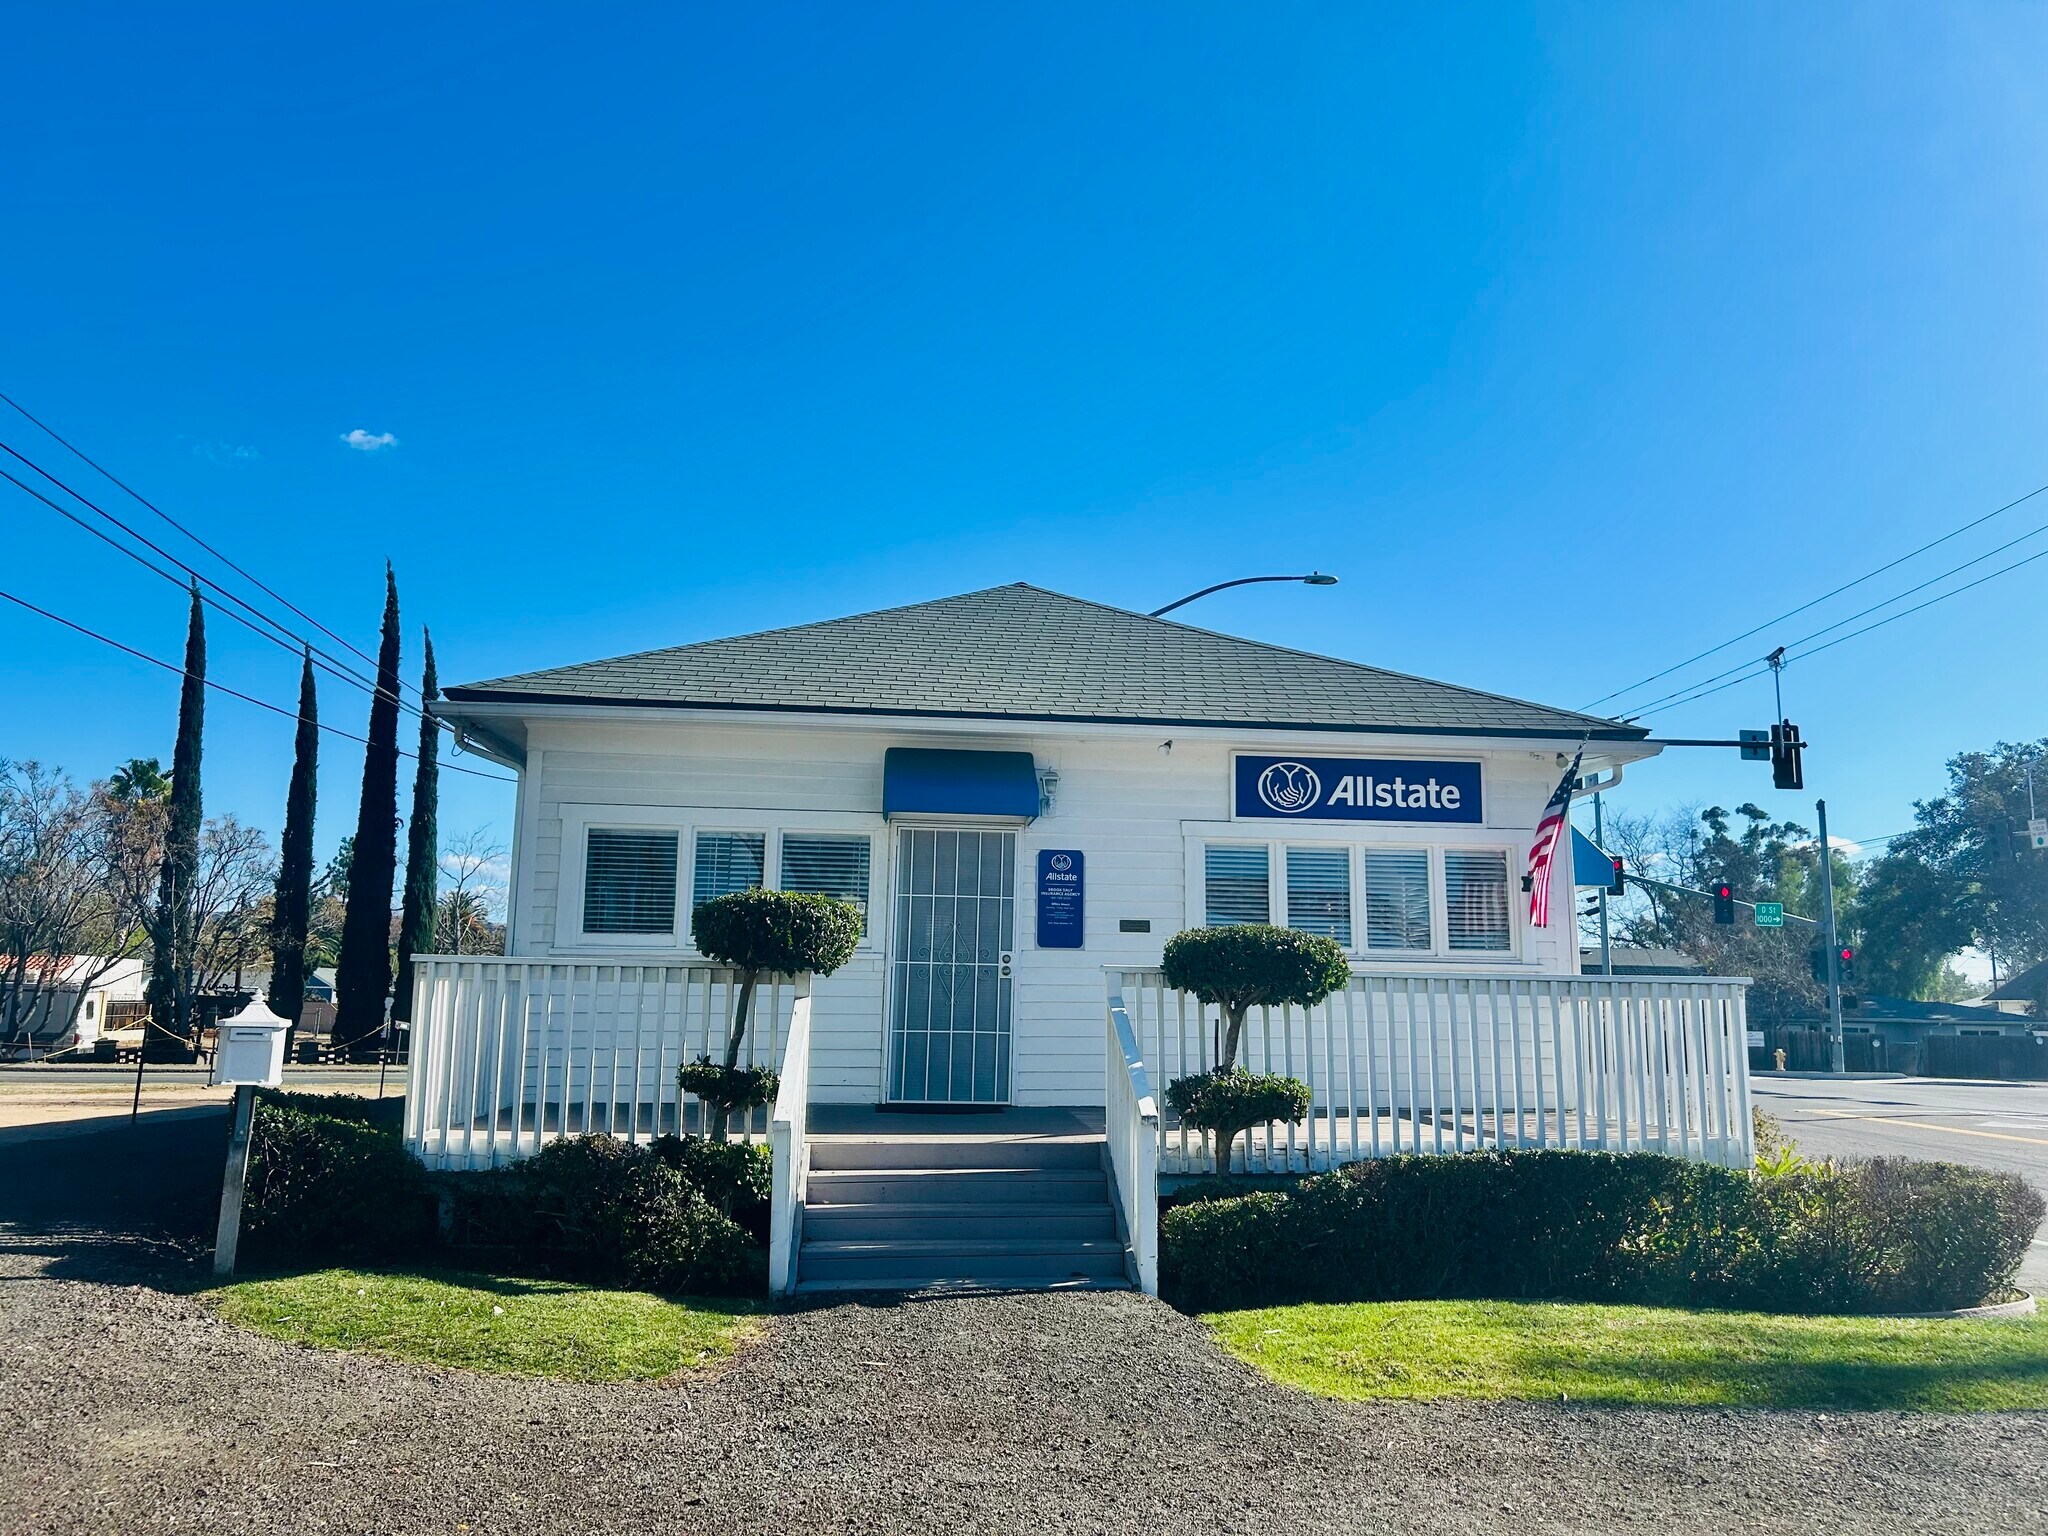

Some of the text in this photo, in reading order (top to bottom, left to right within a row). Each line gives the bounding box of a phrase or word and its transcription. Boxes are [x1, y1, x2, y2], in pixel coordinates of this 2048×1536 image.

[1326, 775, 1461, 809] Allstate
[1045, 872, 1078, 881] Allstate
[1761, 906, 1776, 914] D St
